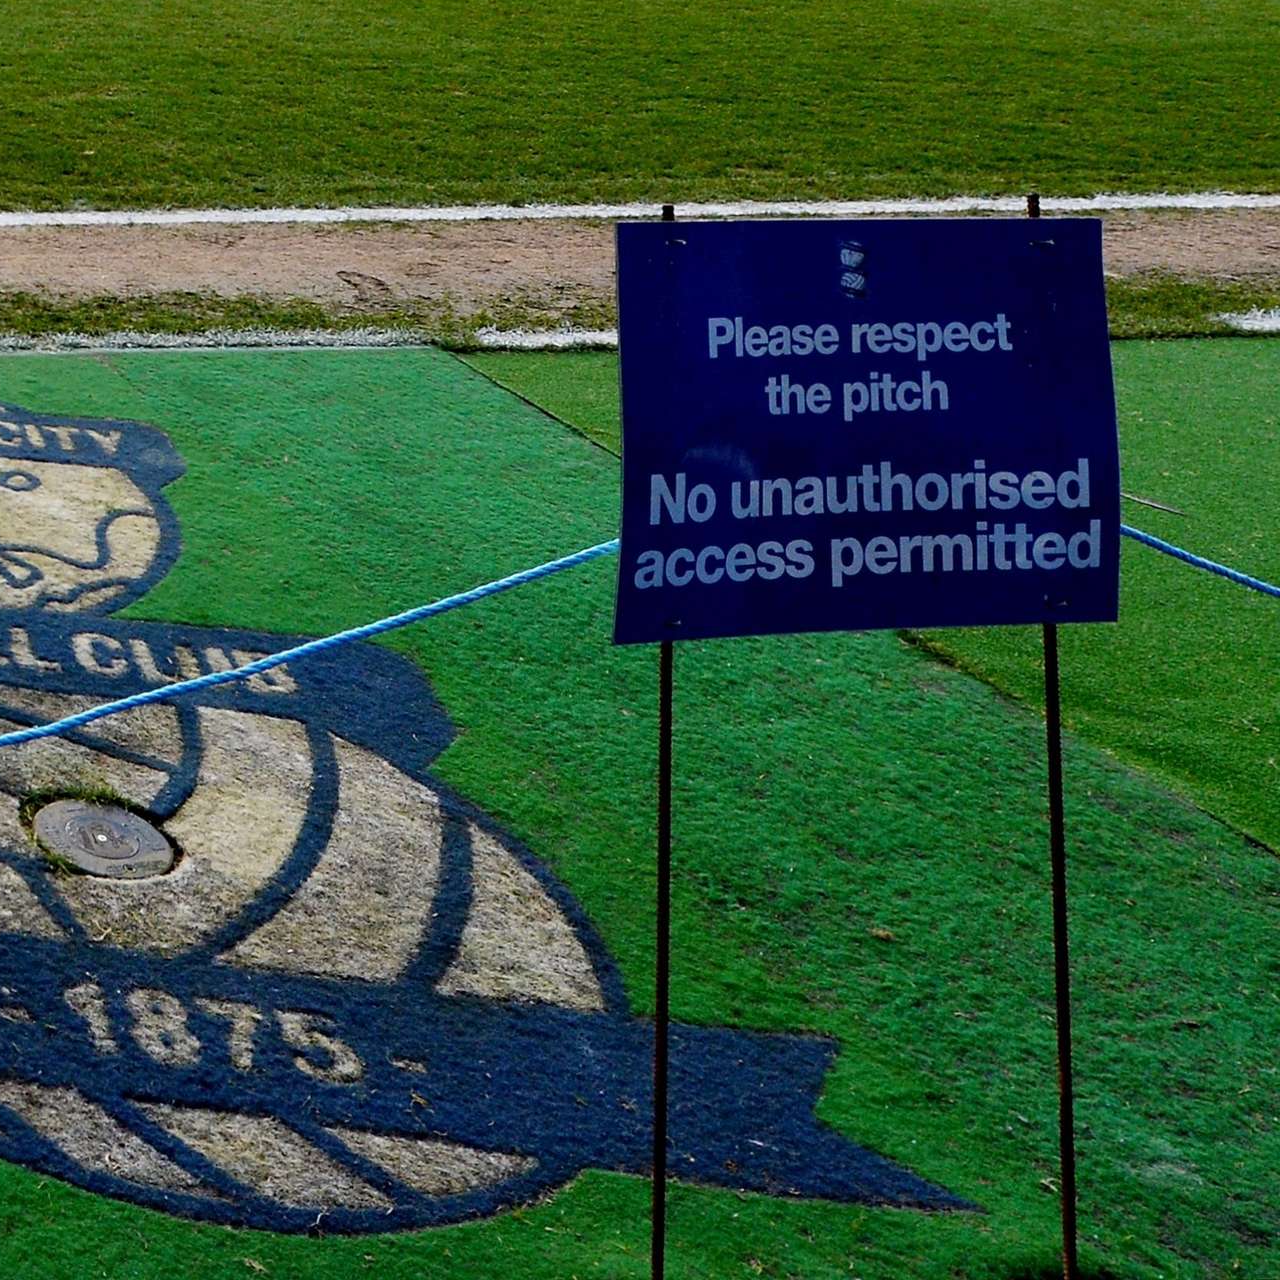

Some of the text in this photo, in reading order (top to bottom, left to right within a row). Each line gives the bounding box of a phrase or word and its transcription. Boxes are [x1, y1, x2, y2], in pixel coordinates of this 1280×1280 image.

[707, 313, 1013, 361] Please respect
[765, 371, 949, 422] the pitch
[649, 458, 1091, 526] No unauthorised
[634, 519, 1102, 590] access permitted
[63, 981, 367, 1084] 1875
